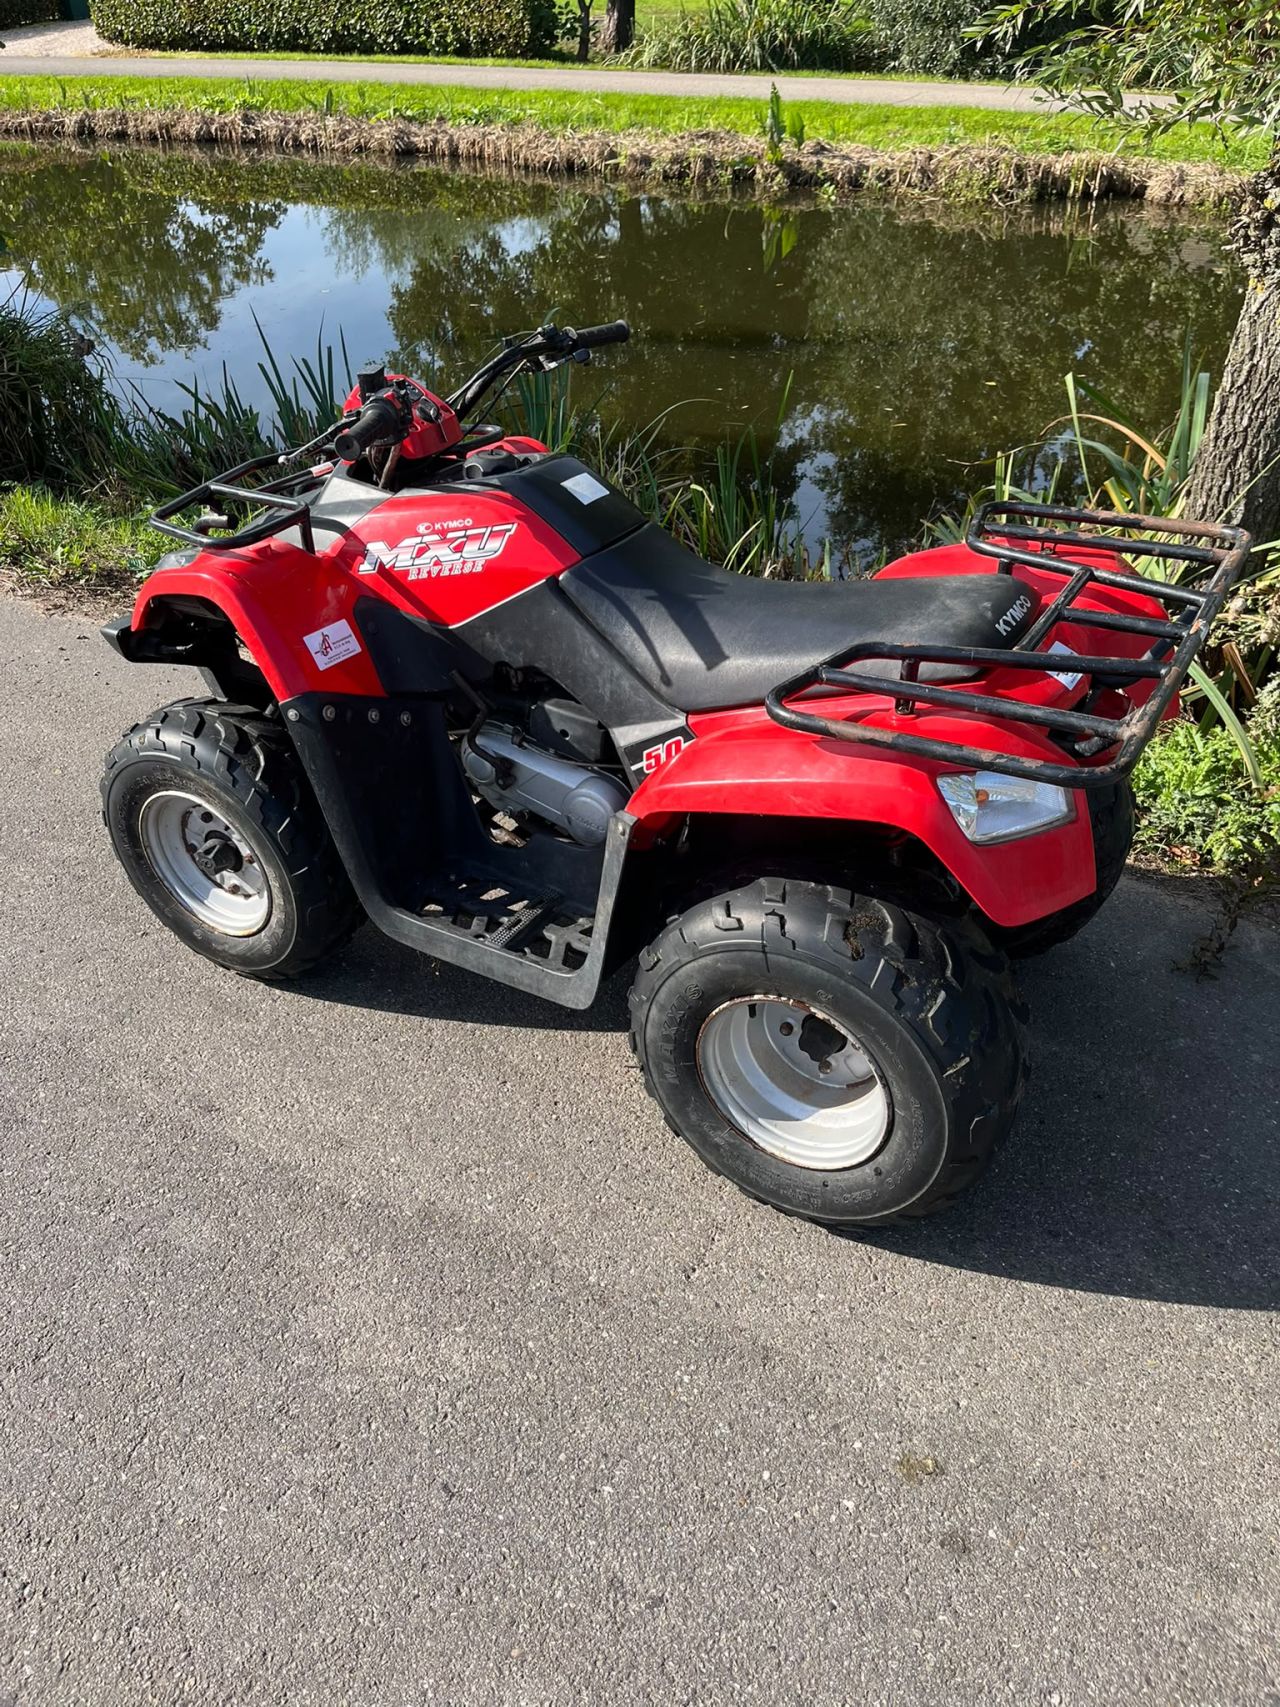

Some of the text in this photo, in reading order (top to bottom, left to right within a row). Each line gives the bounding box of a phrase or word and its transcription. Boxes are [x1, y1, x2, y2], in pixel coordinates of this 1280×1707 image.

[434, 518, 473, 529] KYMCO
[359, 522, 518, 574] MXU
[408, 560, 485, 581] REVERSE
[995, 595, 1032, 636] KYMCO
[643, 735, 684, 774] 50
